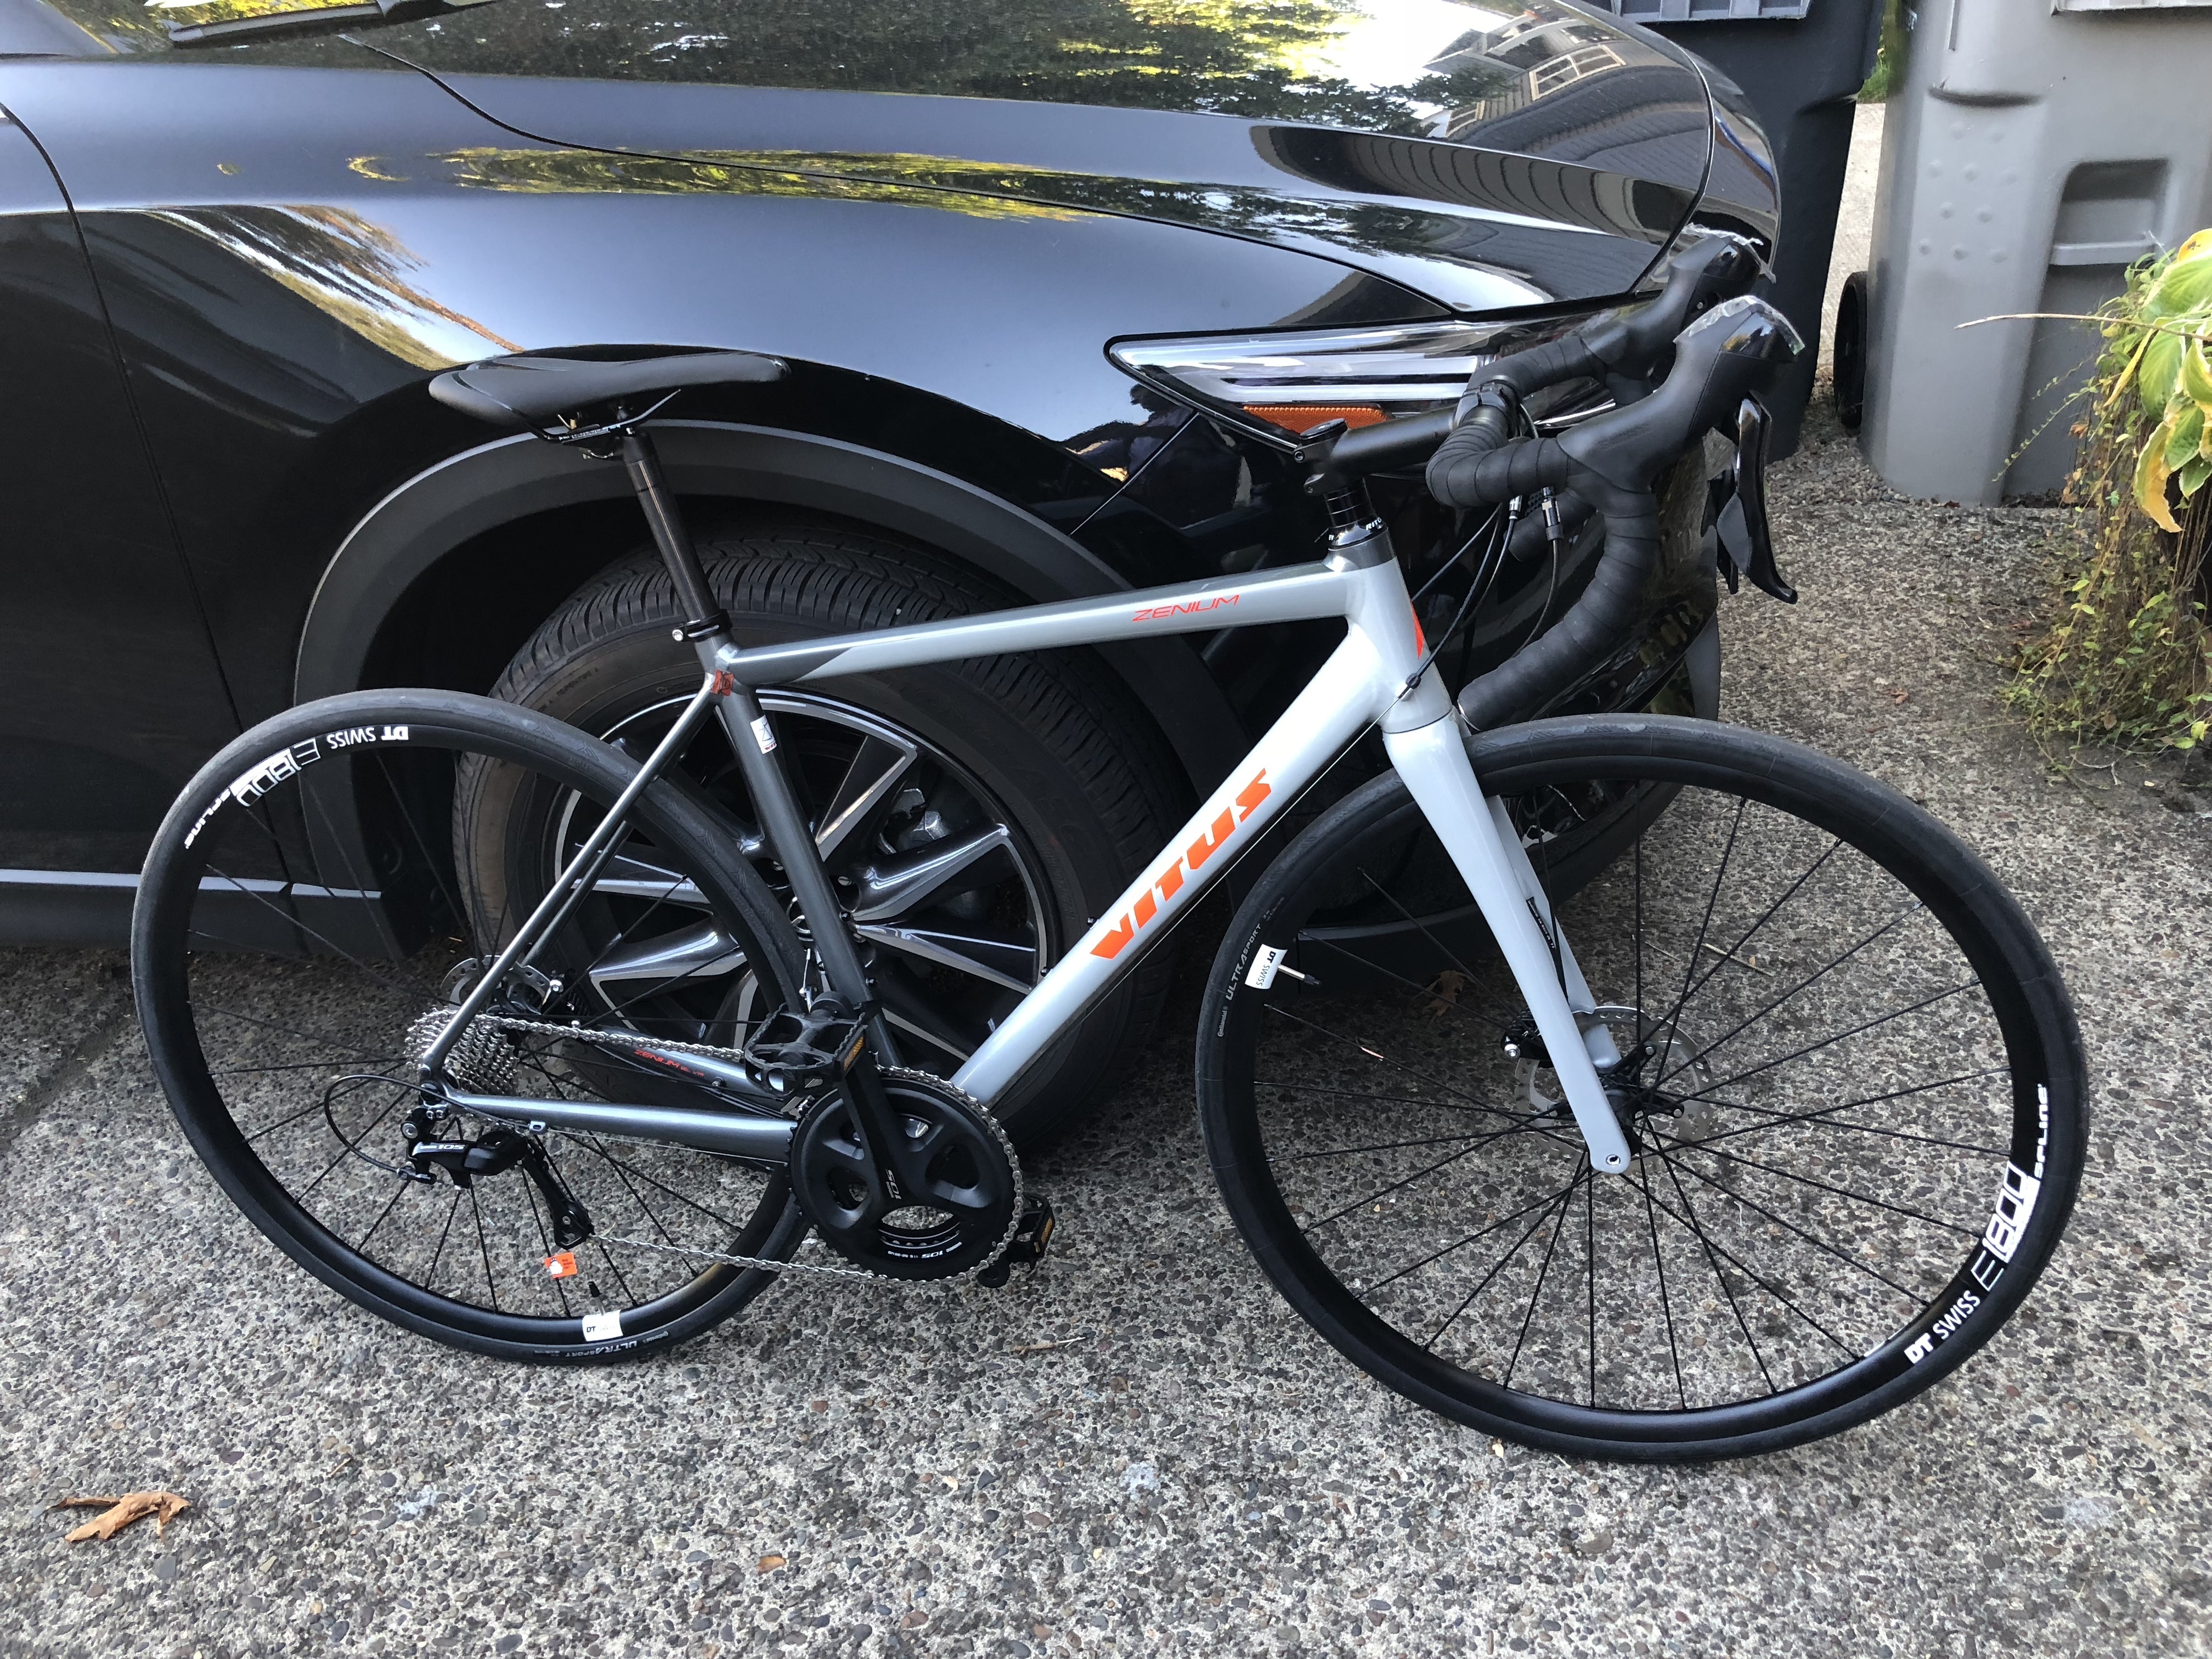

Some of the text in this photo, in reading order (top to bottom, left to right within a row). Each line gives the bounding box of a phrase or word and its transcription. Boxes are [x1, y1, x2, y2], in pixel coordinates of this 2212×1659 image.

[1132, 594, 1240, 622] ZENIUM
[327, 726, 376, 750] SWISS
[381, 726, 409, 741] DT
[1089, 768, 1272, 960] VITUS
[1256, 950, 1277, 986] DT SWISS
[885, 1168, 902, 1200] 105
[921, 1250, 944, 1259] 105
[1904, 1333, 1934, 1365] DT
[1932, 1290, 1980, 1340] SWISS
